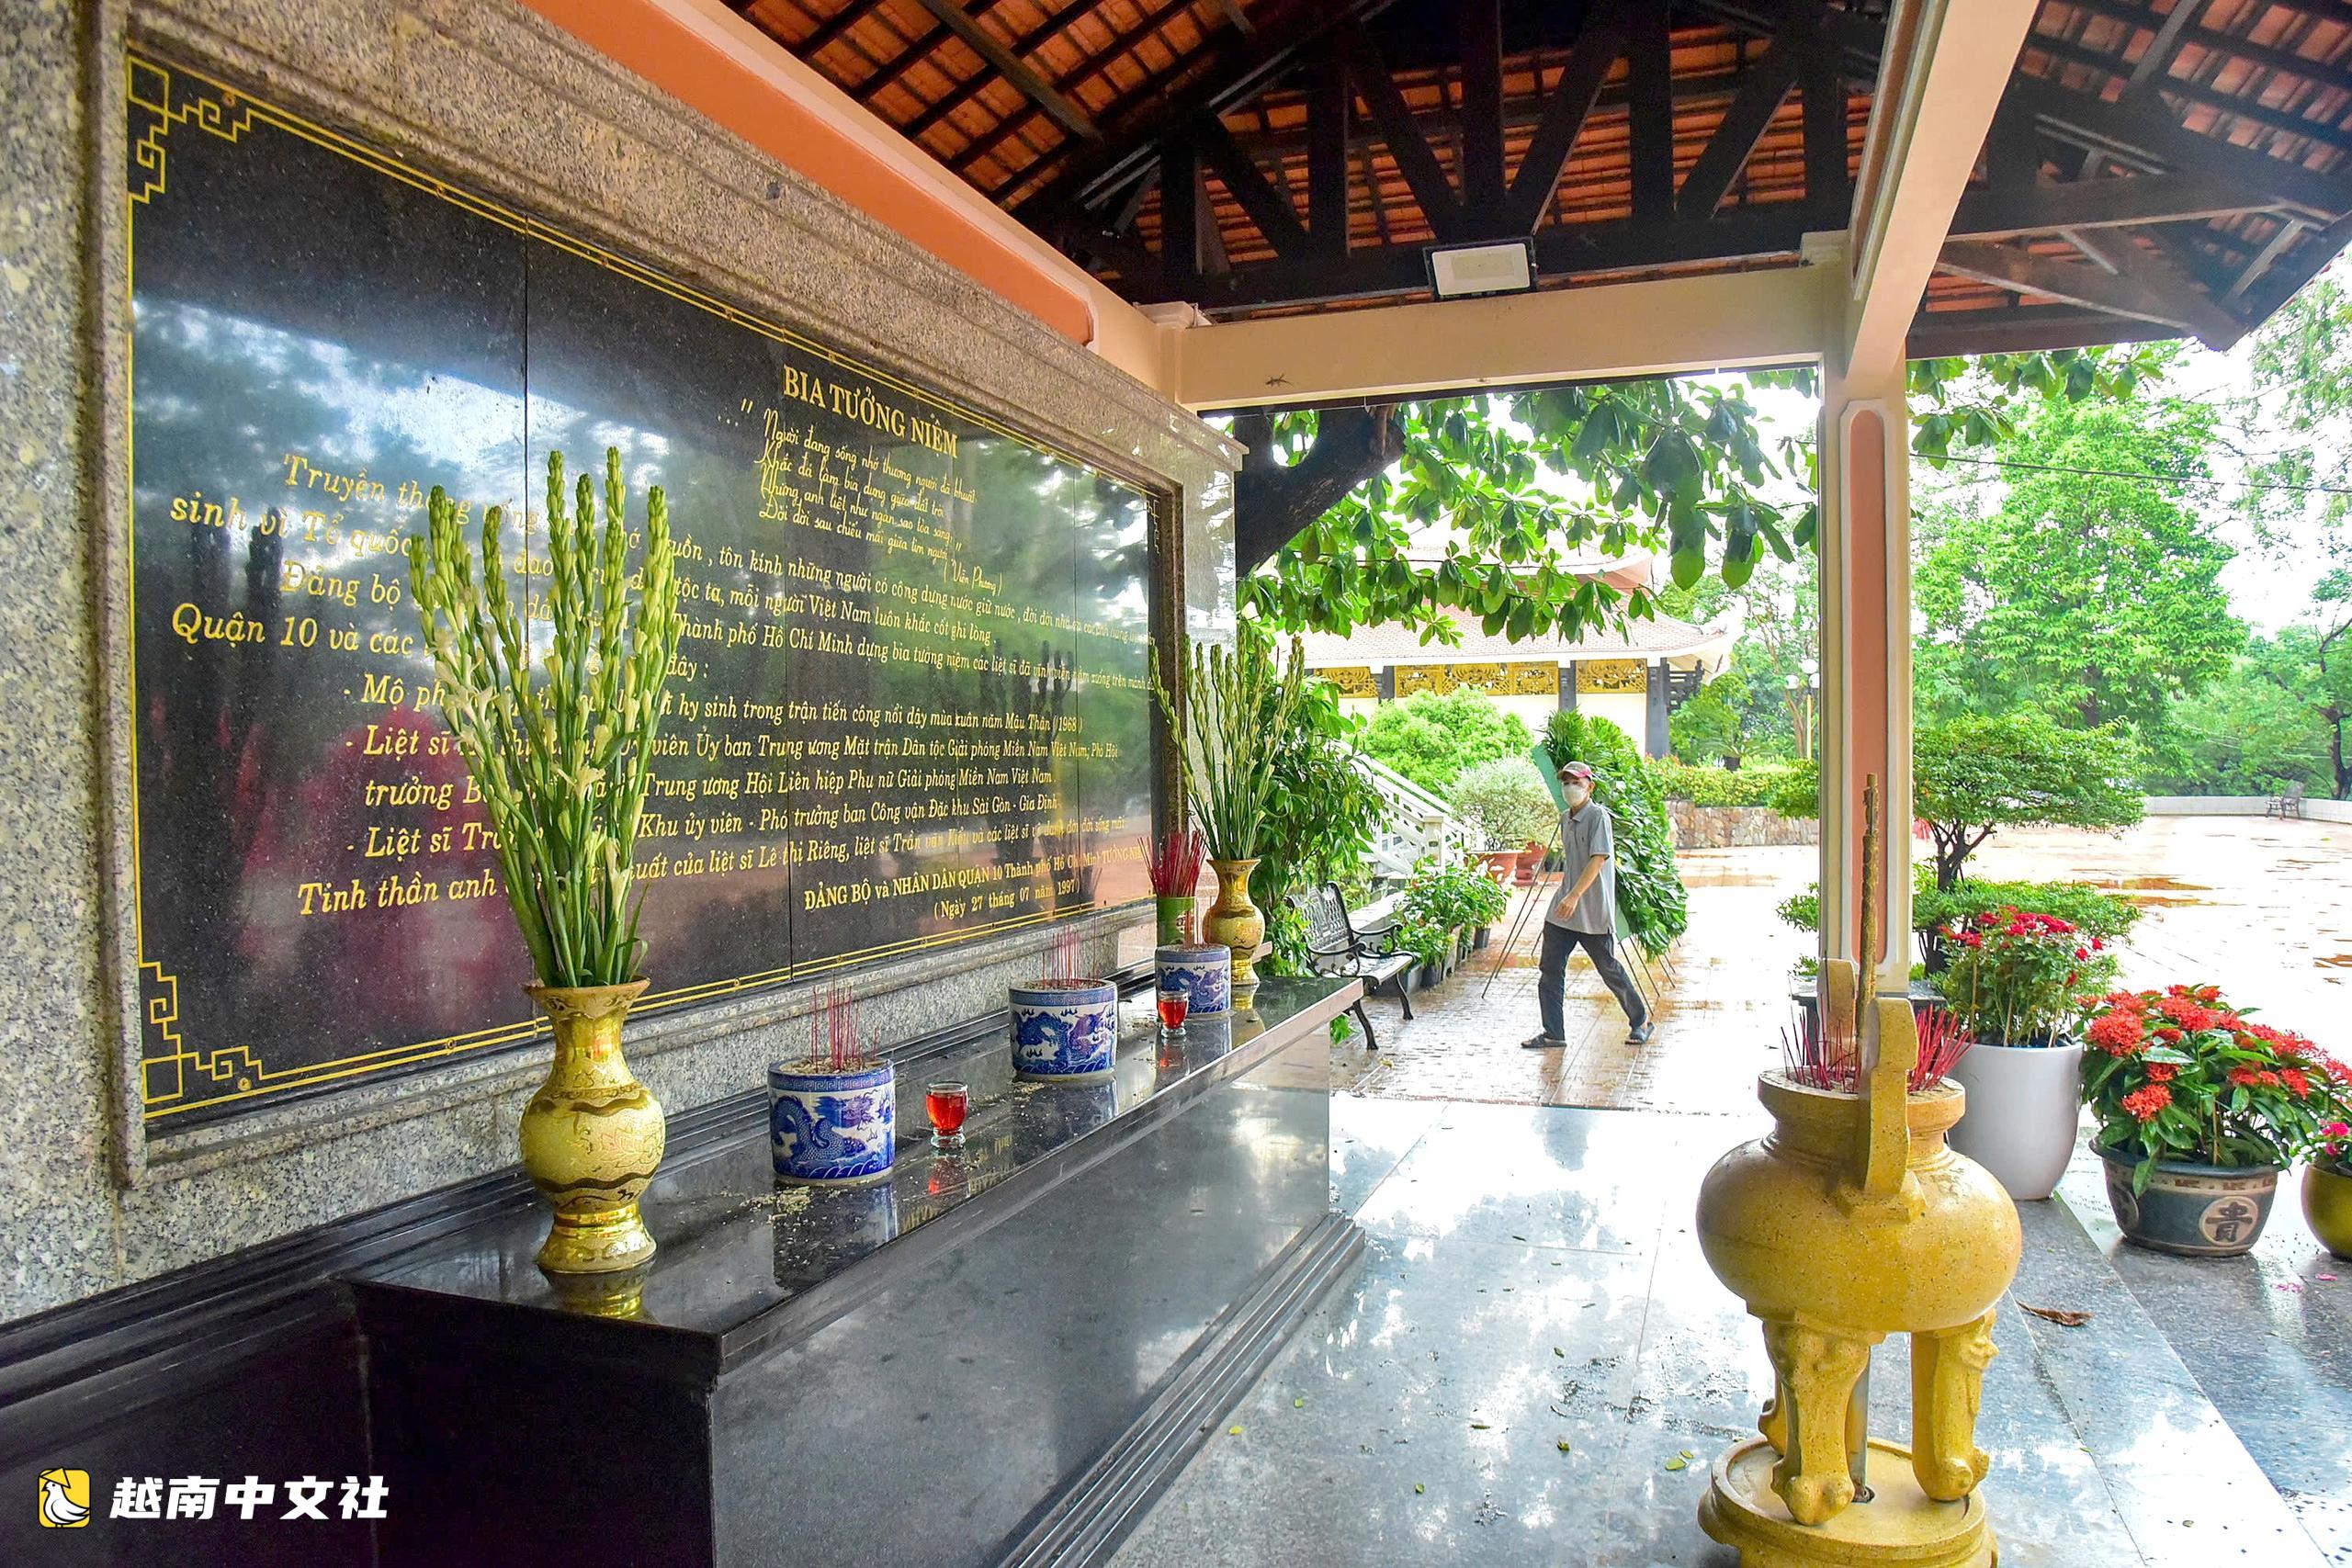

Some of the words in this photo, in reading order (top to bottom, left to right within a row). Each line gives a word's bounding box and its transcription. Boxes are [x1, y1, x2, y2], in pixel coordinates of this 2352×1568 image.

[763, 408, 798, 448] Người
[835, 445, 856, 470] sống
[862, 446, 878, 470] nhớ
[784, 364, 825, 408] BIA
[830, 384, 906, 437] TƯỞNG
[911, 417, 957, 458] NIỆM
[798, 452, 812, 478] đá
[844, 466, 858, 491] bia
[283, 454, 386, 503] Truyền
[718, 547, 744, 569] tôn
[750, 550, 784, 577] kính
[787, 558, 831, 589] những
[836, 567, 872, 592] người
[876, 576, 888, 593] có
[891, 580, 918, 604] công
[922, 586, 948, 612] dựng
[950, 593, 973, 611] nước
[804, 479, 824, 505] anh
[831, 487, 846, 514] liệt
[850, 492, 867, 517] như
[900, 518, 913, 530] sao
[814, 516, 831, 531] sau
[837, 512, 861, 538] chiếu
[170, 492, 246, 530] sinh
[259, 509, 288, 537] vì
[302, 510, 345, 547] Tổ
[349, 525, 413, 558] quốc
[705, 583, 725, 607] ta,
[729, 584, 759, 608] mỗi
[765, 594, 805, 615] người
[809, 593, 837, 622] Việt
[841, 601, 871, 623] Nam
[875, 607, 900, 628] luôn
[904, 611, 931, 633] khắc
[933, 616, 949, 636] cốt
[951, 623, 967, 641] ghi
[173, 603, 266, 649] Quận
[280, 616, 318, 647] 10
[330, 618, 359, 652] và
[369, 626, 413, 656] các
[279, 561, 359, 606] Đảng
[371, 573, 401, 609] bộ
[727, 623, 757, 648] phố
[762, 625, 784, 648] Hồ
[789, 627, 814, 649] Chí
[817, 631, 854, 654] Minh
[892, 641, 910, 661] bia
[913, 646, 943, 669] tưởng
[946, 650, 970, 672] niệm
[973, 654, 989, 671] các
[992, 656, 1007, 677] liệt
[1019, 660, 1030, 676] đã
[361, 672, 403, 711] Mộ
[679, 694, 699, 721] hy
[705, 695, 737, 718] sinh
[743, 702, 783, 725] trong
[788, 701, 817, 724] trận
[822, 699, 847, 721] tiến
[852, 703, 881, 727] công
[885, 703, 902, 724] nổi
[907, 707, 927, 729] dậy
[930, 709, 953, 727] mùa
[955, 710, 978, 728] xuân
[982, 712, 1002, 729] năm
[1005, 713, 1025, 732] Mậu
[1028, 714, 1050, 732] Thân
[363, 725, 420, 761] Liệt
[428, 730, 450, 754] sĩ
[652, 735, 690, 757] viên
[696, 726, 719, 761] Ủy
[724, 735, 752, 757] ban
[758, 735, 803, 761] Trung
[808, 739, 840, 761] ương
[843, 736, 870, 761] Mặt
[874, 737, 899, 761] trận
[901, 737, 925, 758] Dân
[929, 739, 945, 761] tộc
[947, 739, 968, 760] Giải
[970, 739, 1001, 761] phóng
[1002, 739, 1025, 758] Miền
[1028, 740, 1048, 758] Nam
[1051, 740, 1067, 761] Việt
[366, 776, 453, 811] trưởng
[643, 773, 697, 801] Trung
[703, 779, 740, 800] ương
[744, 773, 774, 799] Hội
[778, 771, 814, 794] Liên
[815, 770, 844, 795] hiệp
[847, 770, 874, 794] Phụ
[878, 771, 894, 788] nữ
[898, 770, 922, 788] Giải
[924, 770, 956, 791] phóng
[959, 768, 984, 786] Miền
[987, 769, 1009, 784] Nam
[1012, 768, 1030, 787] Việt
[366, 825, 422, 863] Liệt
[430, 827, 452, 853] sĩ
[639, 814, 678, 839] Khu
[685, 812, 706, 840] ủy
[710, 813, 743, 834] viên
[758, 808, 788, 831] Phó
[794, 804, 840, 829] trưởng
[843, 804, 866, 823] ban
[871, 801, 900, 824] Công
[904, 800, 925, 823] vận
[928, 798, 948, 820] Đặc
[951, 798, 970, 817] khu
[972, 795, 989, 814] Sài
[992, 795, 1011, 813] Gòn
[1019, 795, 1035, 812] Gia
[1037, 794, 1057, 813] Định
[298, 879, 367, 916] Tinh
[379, 871, 439, 908] thần
[448, 870, 497, 900] anh
[674, 851, 705, 876] của
[709, 850, 735, 878] liệt
[740, 848, 754, 871] sĩ
[759, 845, 777, 868] Lê
[783, 841, 804, 868] thị
[808, 840, 850, 863] Riêng,
[854, 836, 876, 863] liệt
[879, 837, 889, 854] sĩ
[892, 832, 921, 854] Trần
[987, 826, 1002, 842] các
[1004, 824, 1019, 844] liệt
[1021, 824, 1029, 839] sĩ
[804, 881, 848, 908] ĐẢNG
[851, 878, 871, 907] BỘ
[876, 879, 889, 898] và
[892, 874, 930, 897] NHÂN
[933, 868, 958, 890] DÂN
[958, 864, 989, 888] QUẬN
[992, 865, 1002, 880] 10
[1005, 861, 1034, 878] Thành
[1035, 855, 1052, 876] phố
[1054, 854, 1065, 871] Hồ
[971, 896, 983, 912] 27
[989, 891, 1015, 908] tháng
[1019, 886, 1029, 902] 07
